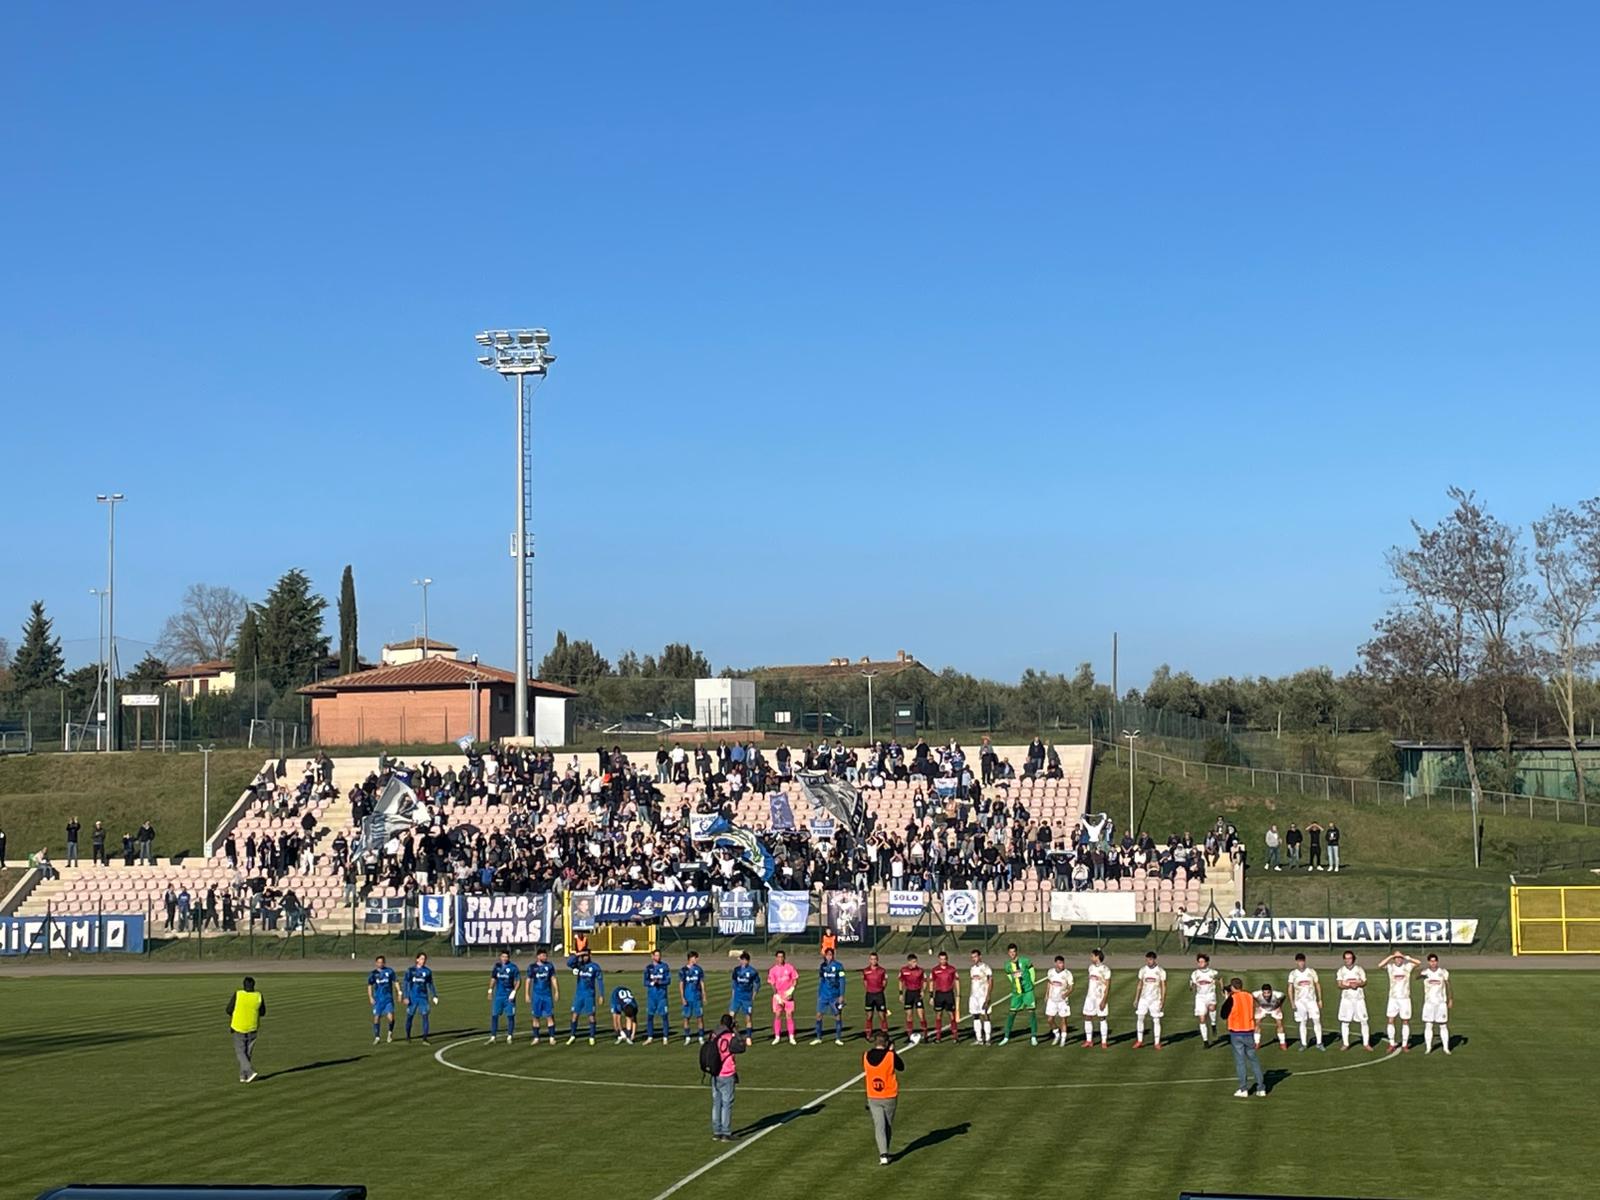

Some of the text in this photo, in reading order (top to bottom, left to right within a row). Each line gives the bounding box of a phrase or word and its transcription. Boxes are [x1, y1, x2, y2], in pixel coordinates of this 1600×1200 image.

[661, 894, 709, 912] KAOS
[893, 893, 919, 902] SOLO
[466, 896, 528, 919] PRATO
[890, 907, 922, 915] PRATO
[464, 919, 541, 944] ULTRAS
[1225, 920, 1325, 940] AVANTI
